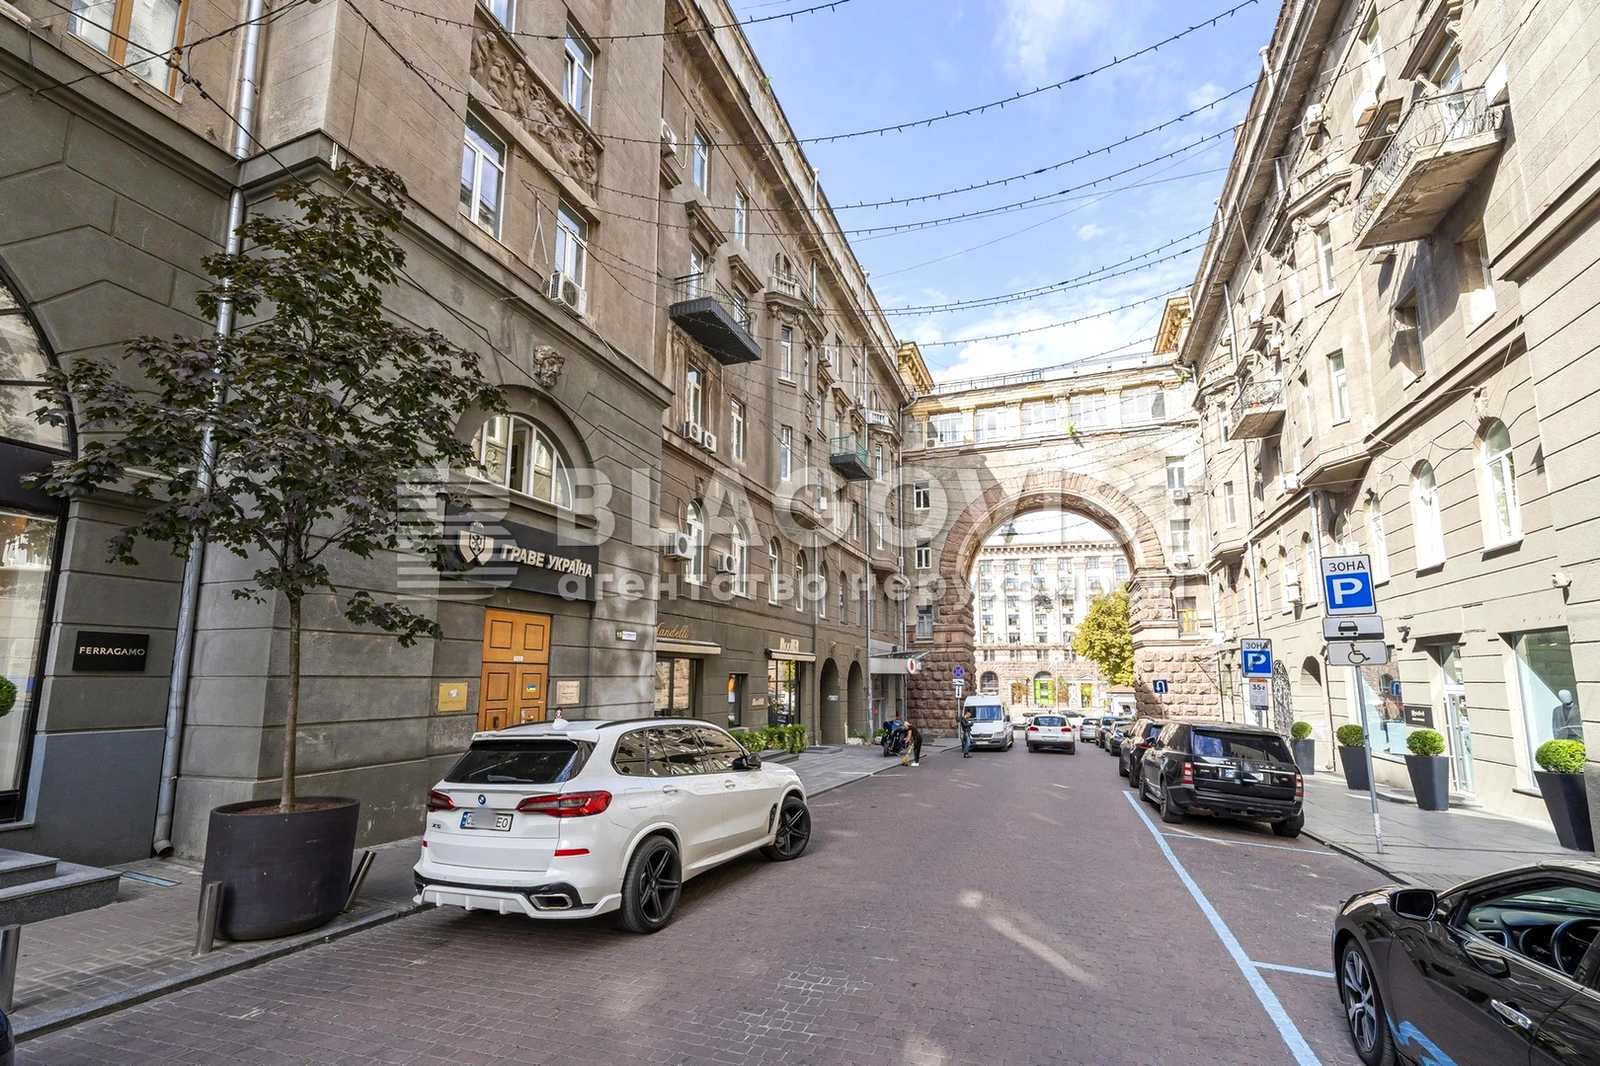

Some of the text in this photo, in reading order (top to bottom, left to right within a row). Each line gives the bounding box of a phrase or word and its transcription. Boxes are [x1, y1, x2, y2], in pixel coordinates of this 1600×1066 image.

[547, 553, 593, 577] УКРАЇНА
[1329, 560, 1366, 572] ЗОНА
[79, 646, 146, 656] FERRAGAMO
[1245, 642, 1269, 650] ЗОНА
